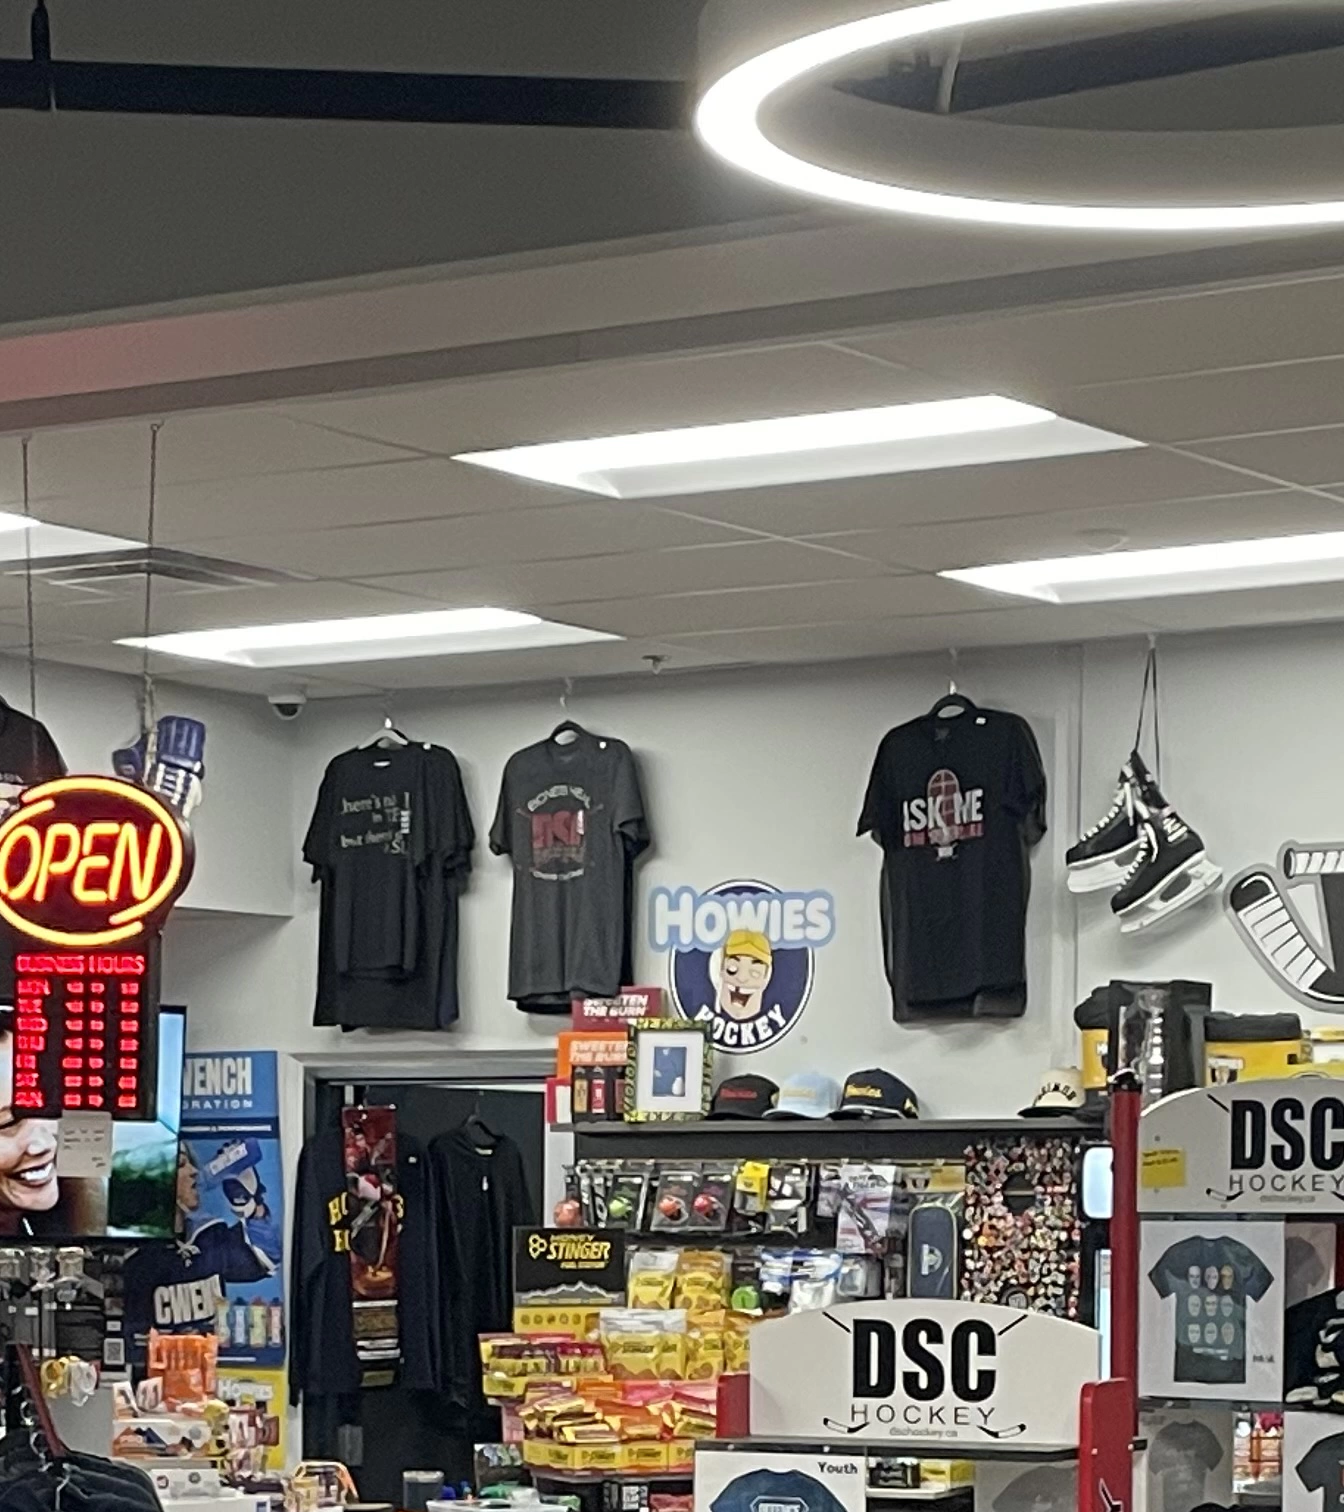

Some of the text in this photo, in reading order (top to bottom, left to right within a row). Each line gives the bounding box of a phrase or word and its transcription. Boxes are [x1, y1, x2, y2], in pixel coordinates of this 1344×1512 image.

[654, 889, 834, 947] HOWIES
[546, 1240, 612, 1261] STINGER
[852, 1316, 998, 1403] DSC
[850, 1403, 996, 1426] HOCKEY
[818, 1461, 859, 1476] Youth
